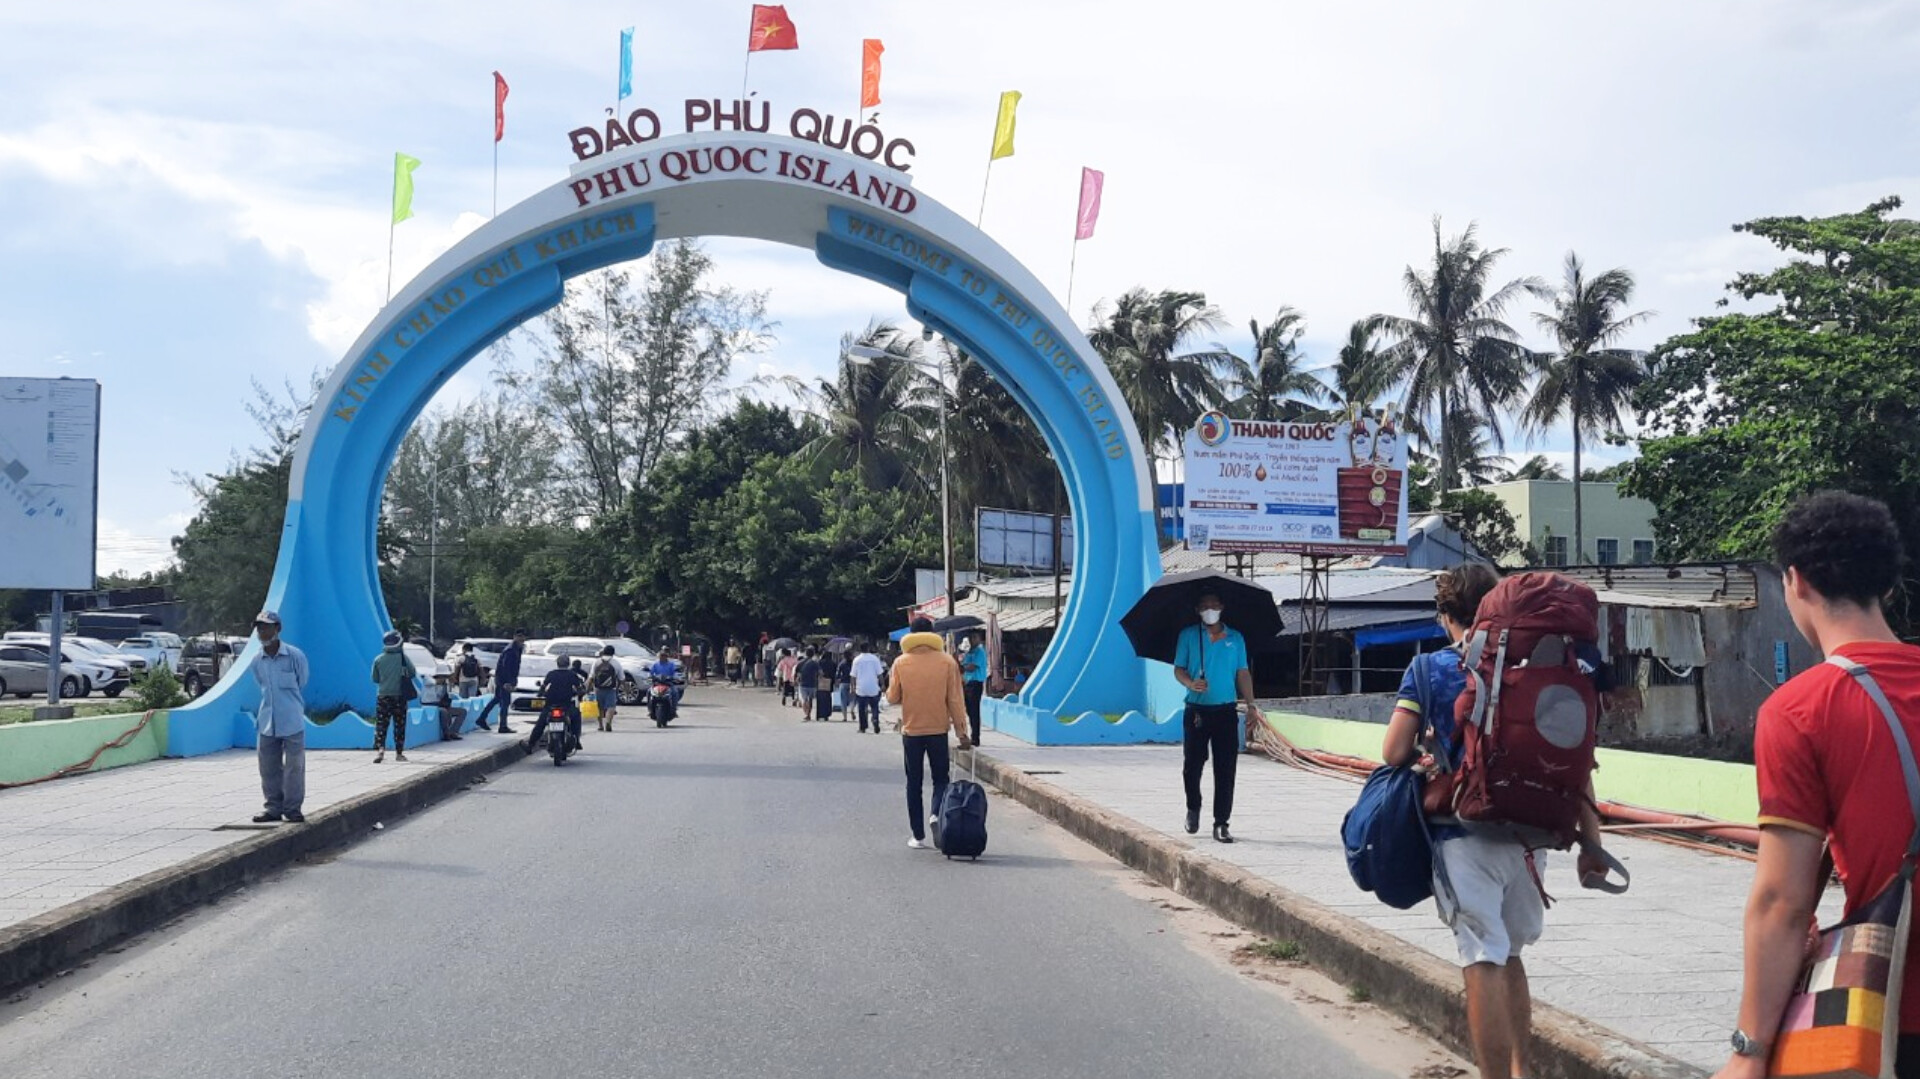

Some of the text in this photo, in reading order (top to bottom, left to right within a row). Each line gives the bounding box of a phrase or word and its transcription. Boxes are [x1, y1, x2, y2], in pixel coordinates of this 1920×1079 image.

[568, 91, 916, 173] ĐẢO PHÚ QUỐC
[569, 146, 917, 214] PHU QUOC ISLAND
[847, 214, 1125, 460] WELCOME TO PHU QUOC ISLAND
[1231, 422, 1285, 439] THANH
[1288, 421, 1336, 441] QUỐC
[1218, 462, 1252, 478] 100%
